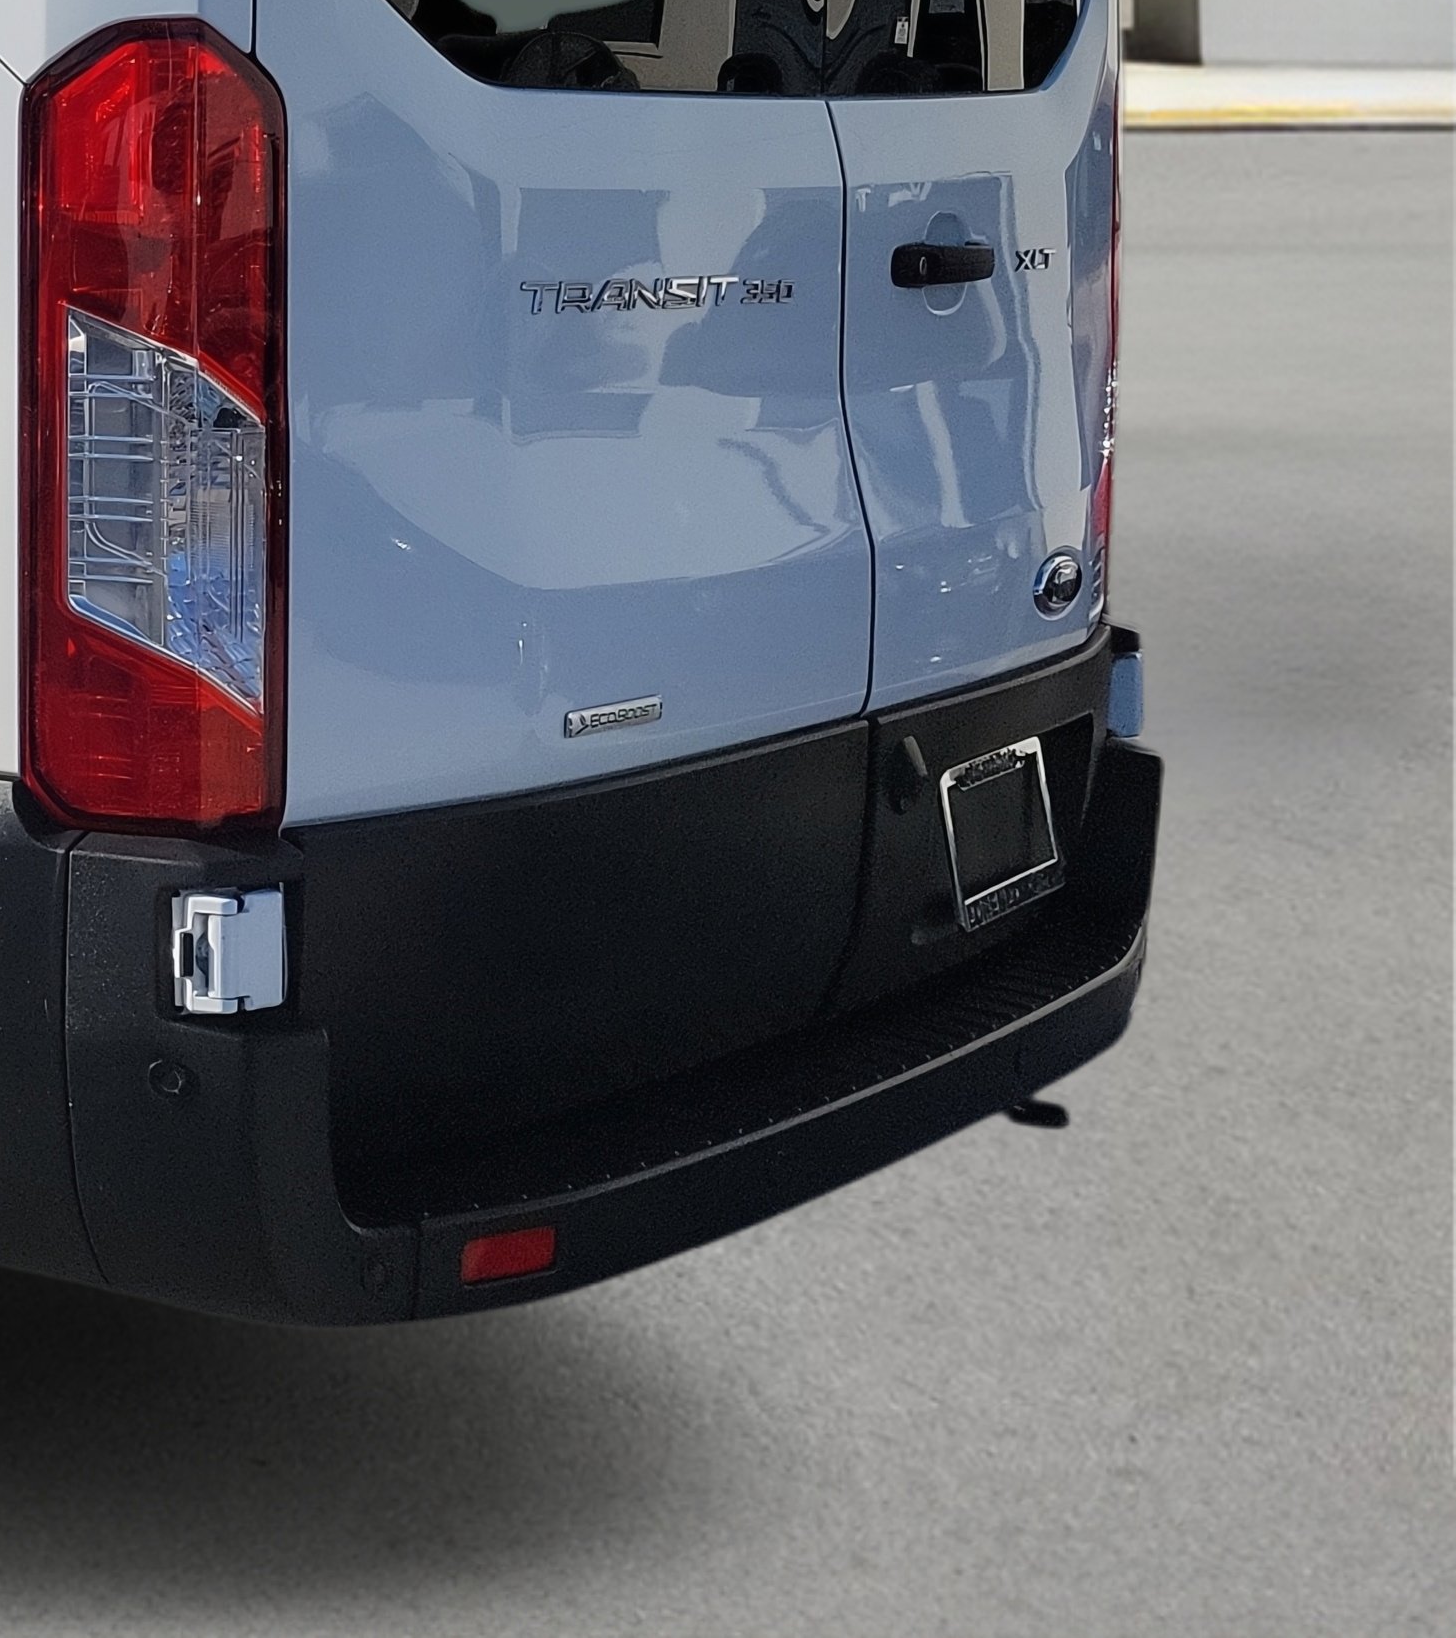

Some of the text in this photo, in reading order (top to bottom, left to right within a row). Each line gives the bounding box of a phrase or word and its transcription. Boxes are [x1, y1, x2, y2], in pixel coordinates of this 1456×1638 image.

[1015, 248, 1056, 272] XLT
[520, 276, 795, 315] TRANSIT 350
